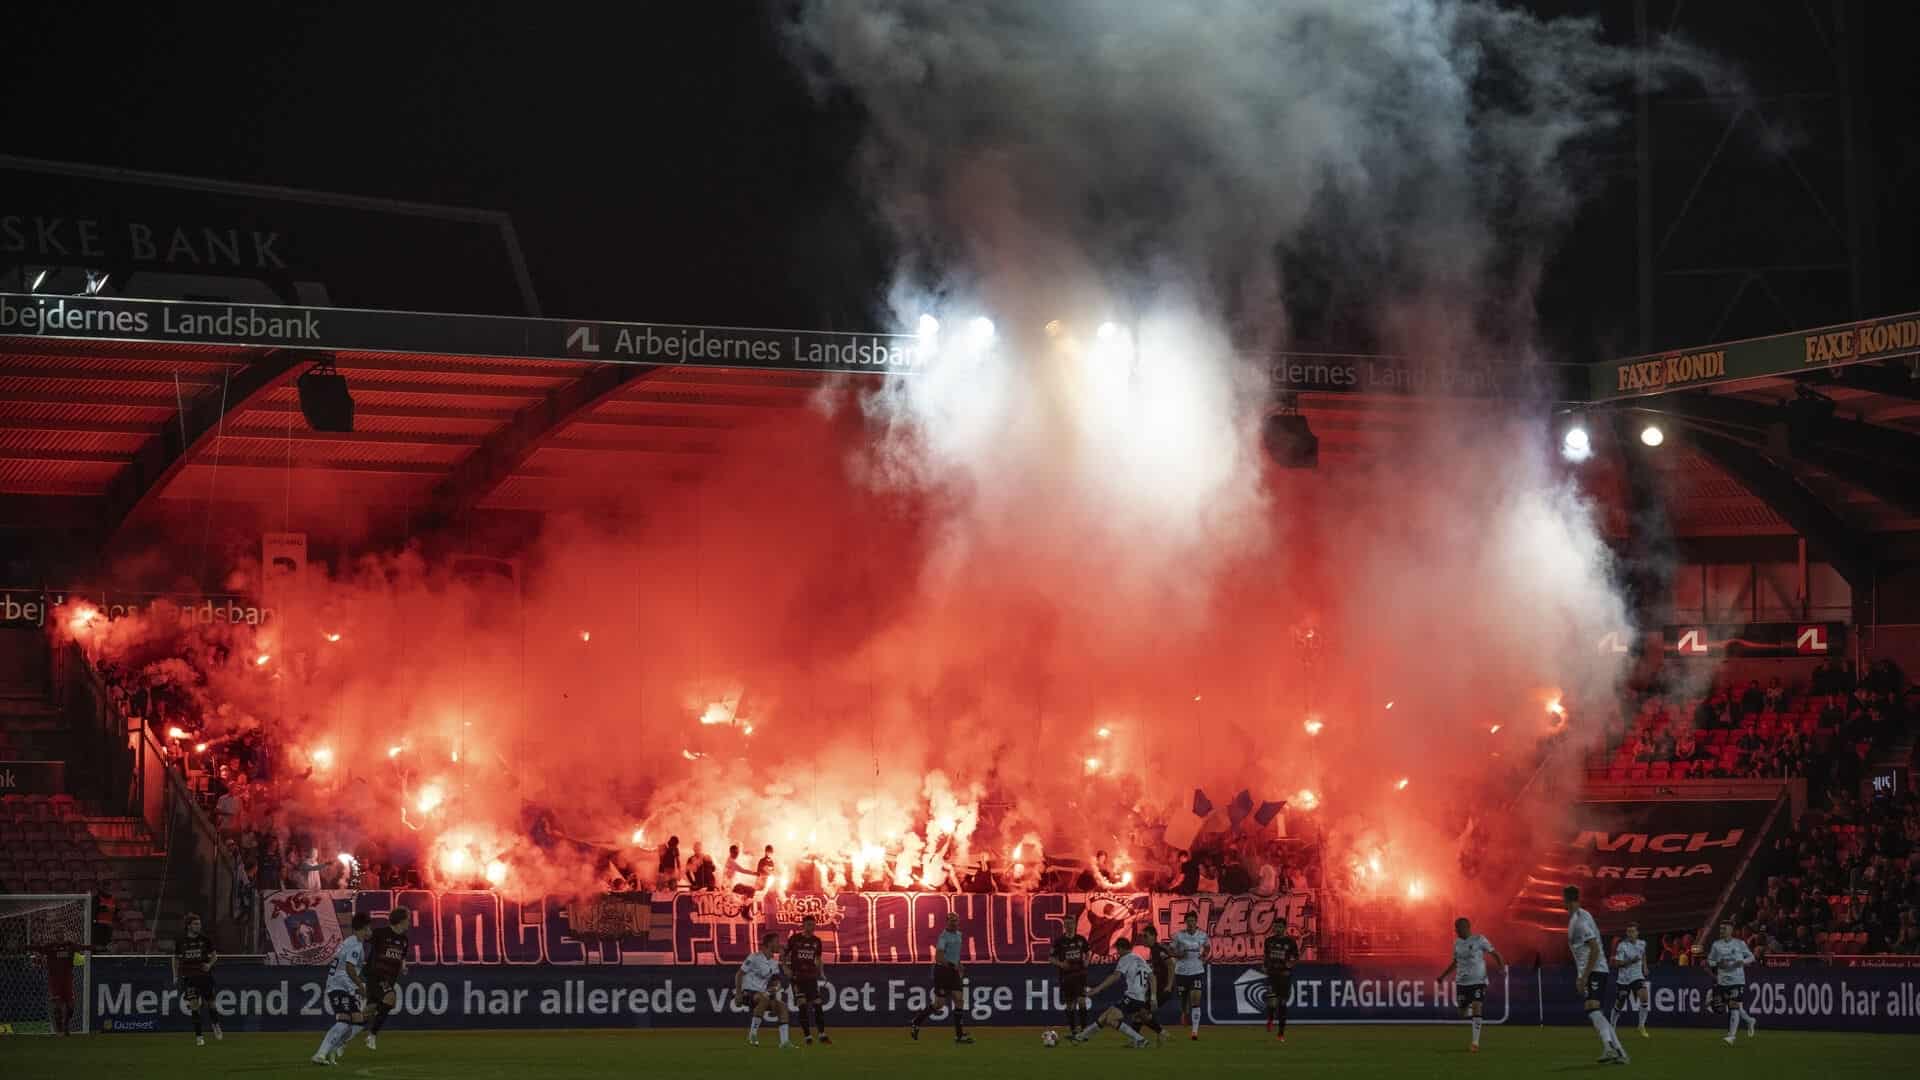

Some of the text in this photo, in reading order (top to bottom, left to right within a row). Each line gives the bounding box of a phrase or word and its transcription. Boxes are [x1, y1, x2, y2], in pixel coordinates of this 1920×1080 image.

[130, 223, 287, 270] BANK
[163, 304, 321, 341] Landsbank
[614, 327, 781, 366] Arbejdernes
[793, 335, 914, 367] Landsba
[1804, 328, 1857, 364] FAXE
[1616, 350, 1726, 392] FAXE KONDI
[1572, 827, 1745, 854] MCH
[1573, 863, 1713, 881] ARENA
[215, 979, 289, 1016] end
[463, 979, 529, 1015] har
[540, 979, 697, 1015] allerede
[816, 979, 877, 1013] Det
[887, 977, 1014, 1021] Fagige
[1330, 978, 1425, 1009] FAGLIGE
[1748, 981, 1833, 1016] 205.000
[1841, 980, 1883, 1016] har
